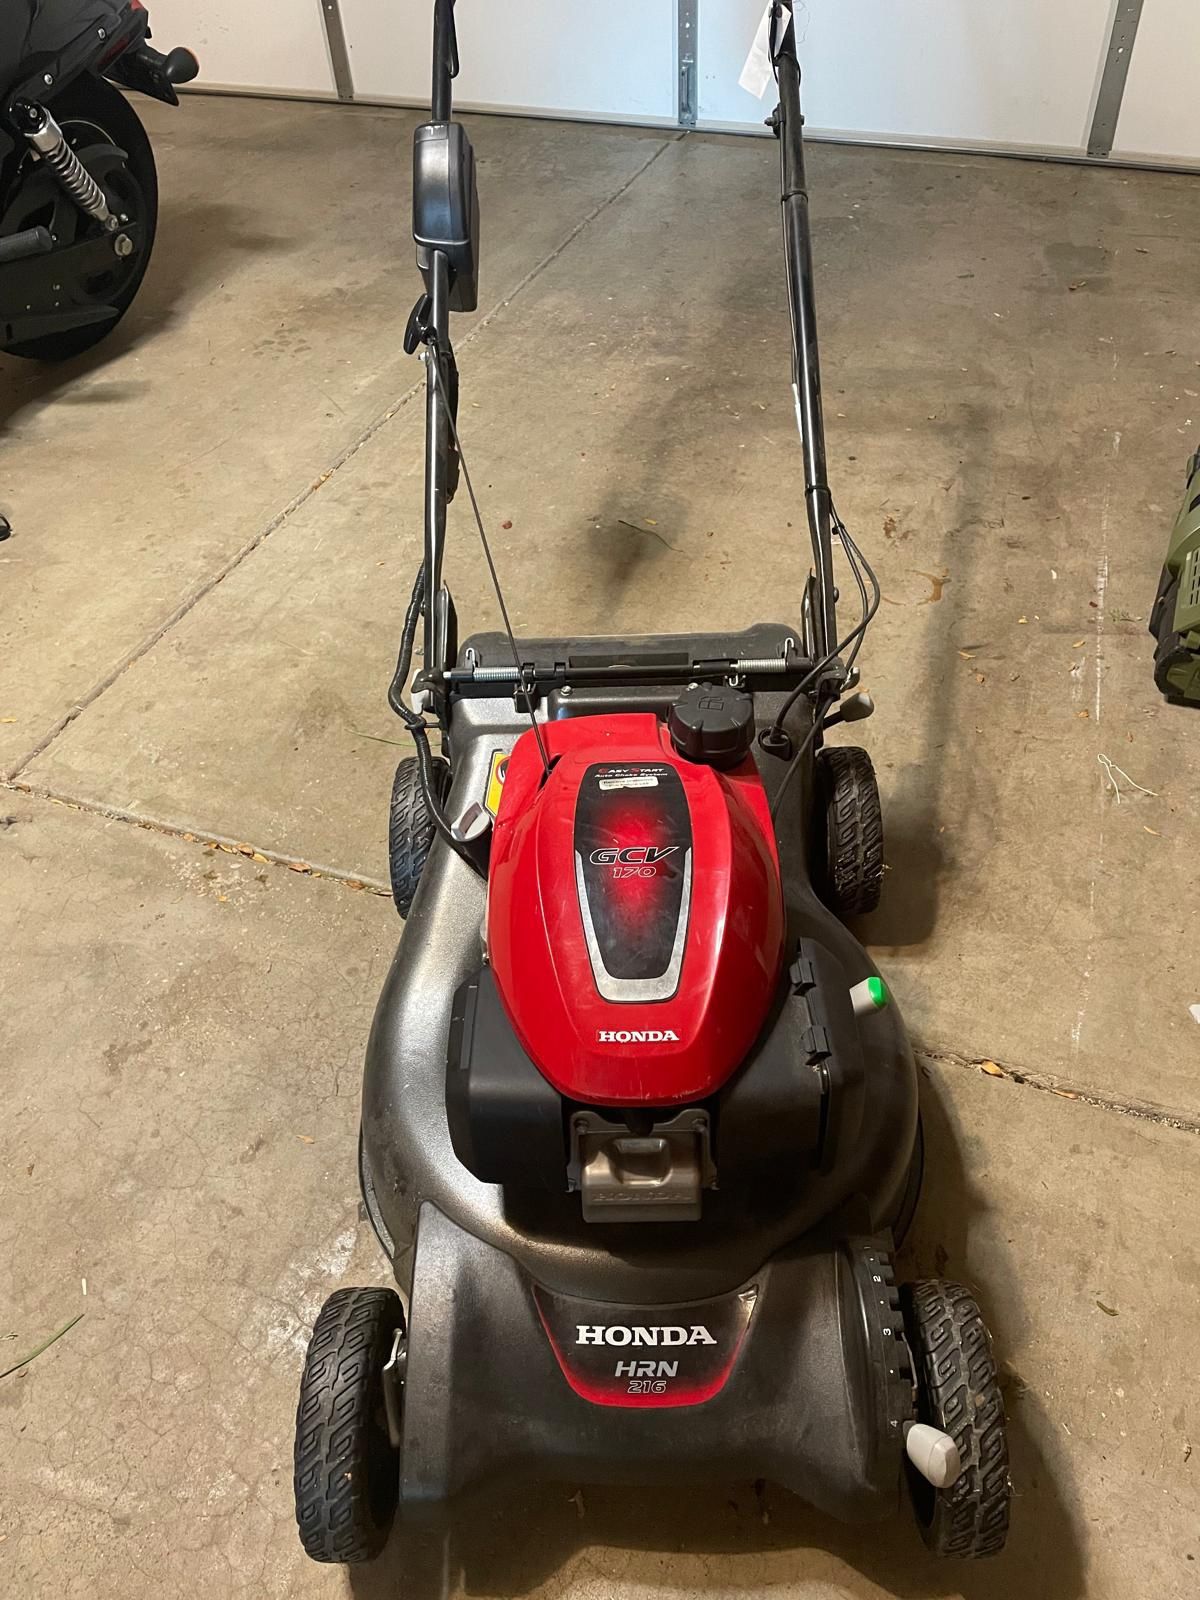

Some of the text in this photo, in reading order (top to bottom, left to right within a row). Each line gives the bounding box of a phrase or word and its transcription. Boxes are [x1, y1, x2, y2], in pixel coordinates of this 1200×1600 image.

[589, 846, 680, 865] GCV
[613, 866, 657, 878] 170
[598, 1030, 680, 1043] HONDA
[873, 1275, 882, 1283] 2
[575, 1324, 718, 1347] HONDA
[883, 1327, 892, 1336] 3
[614, 1360, 679, 1377] HRN
[627, 1380, 667, 1394] 216
[890, 1419, 899, 1428] 4
